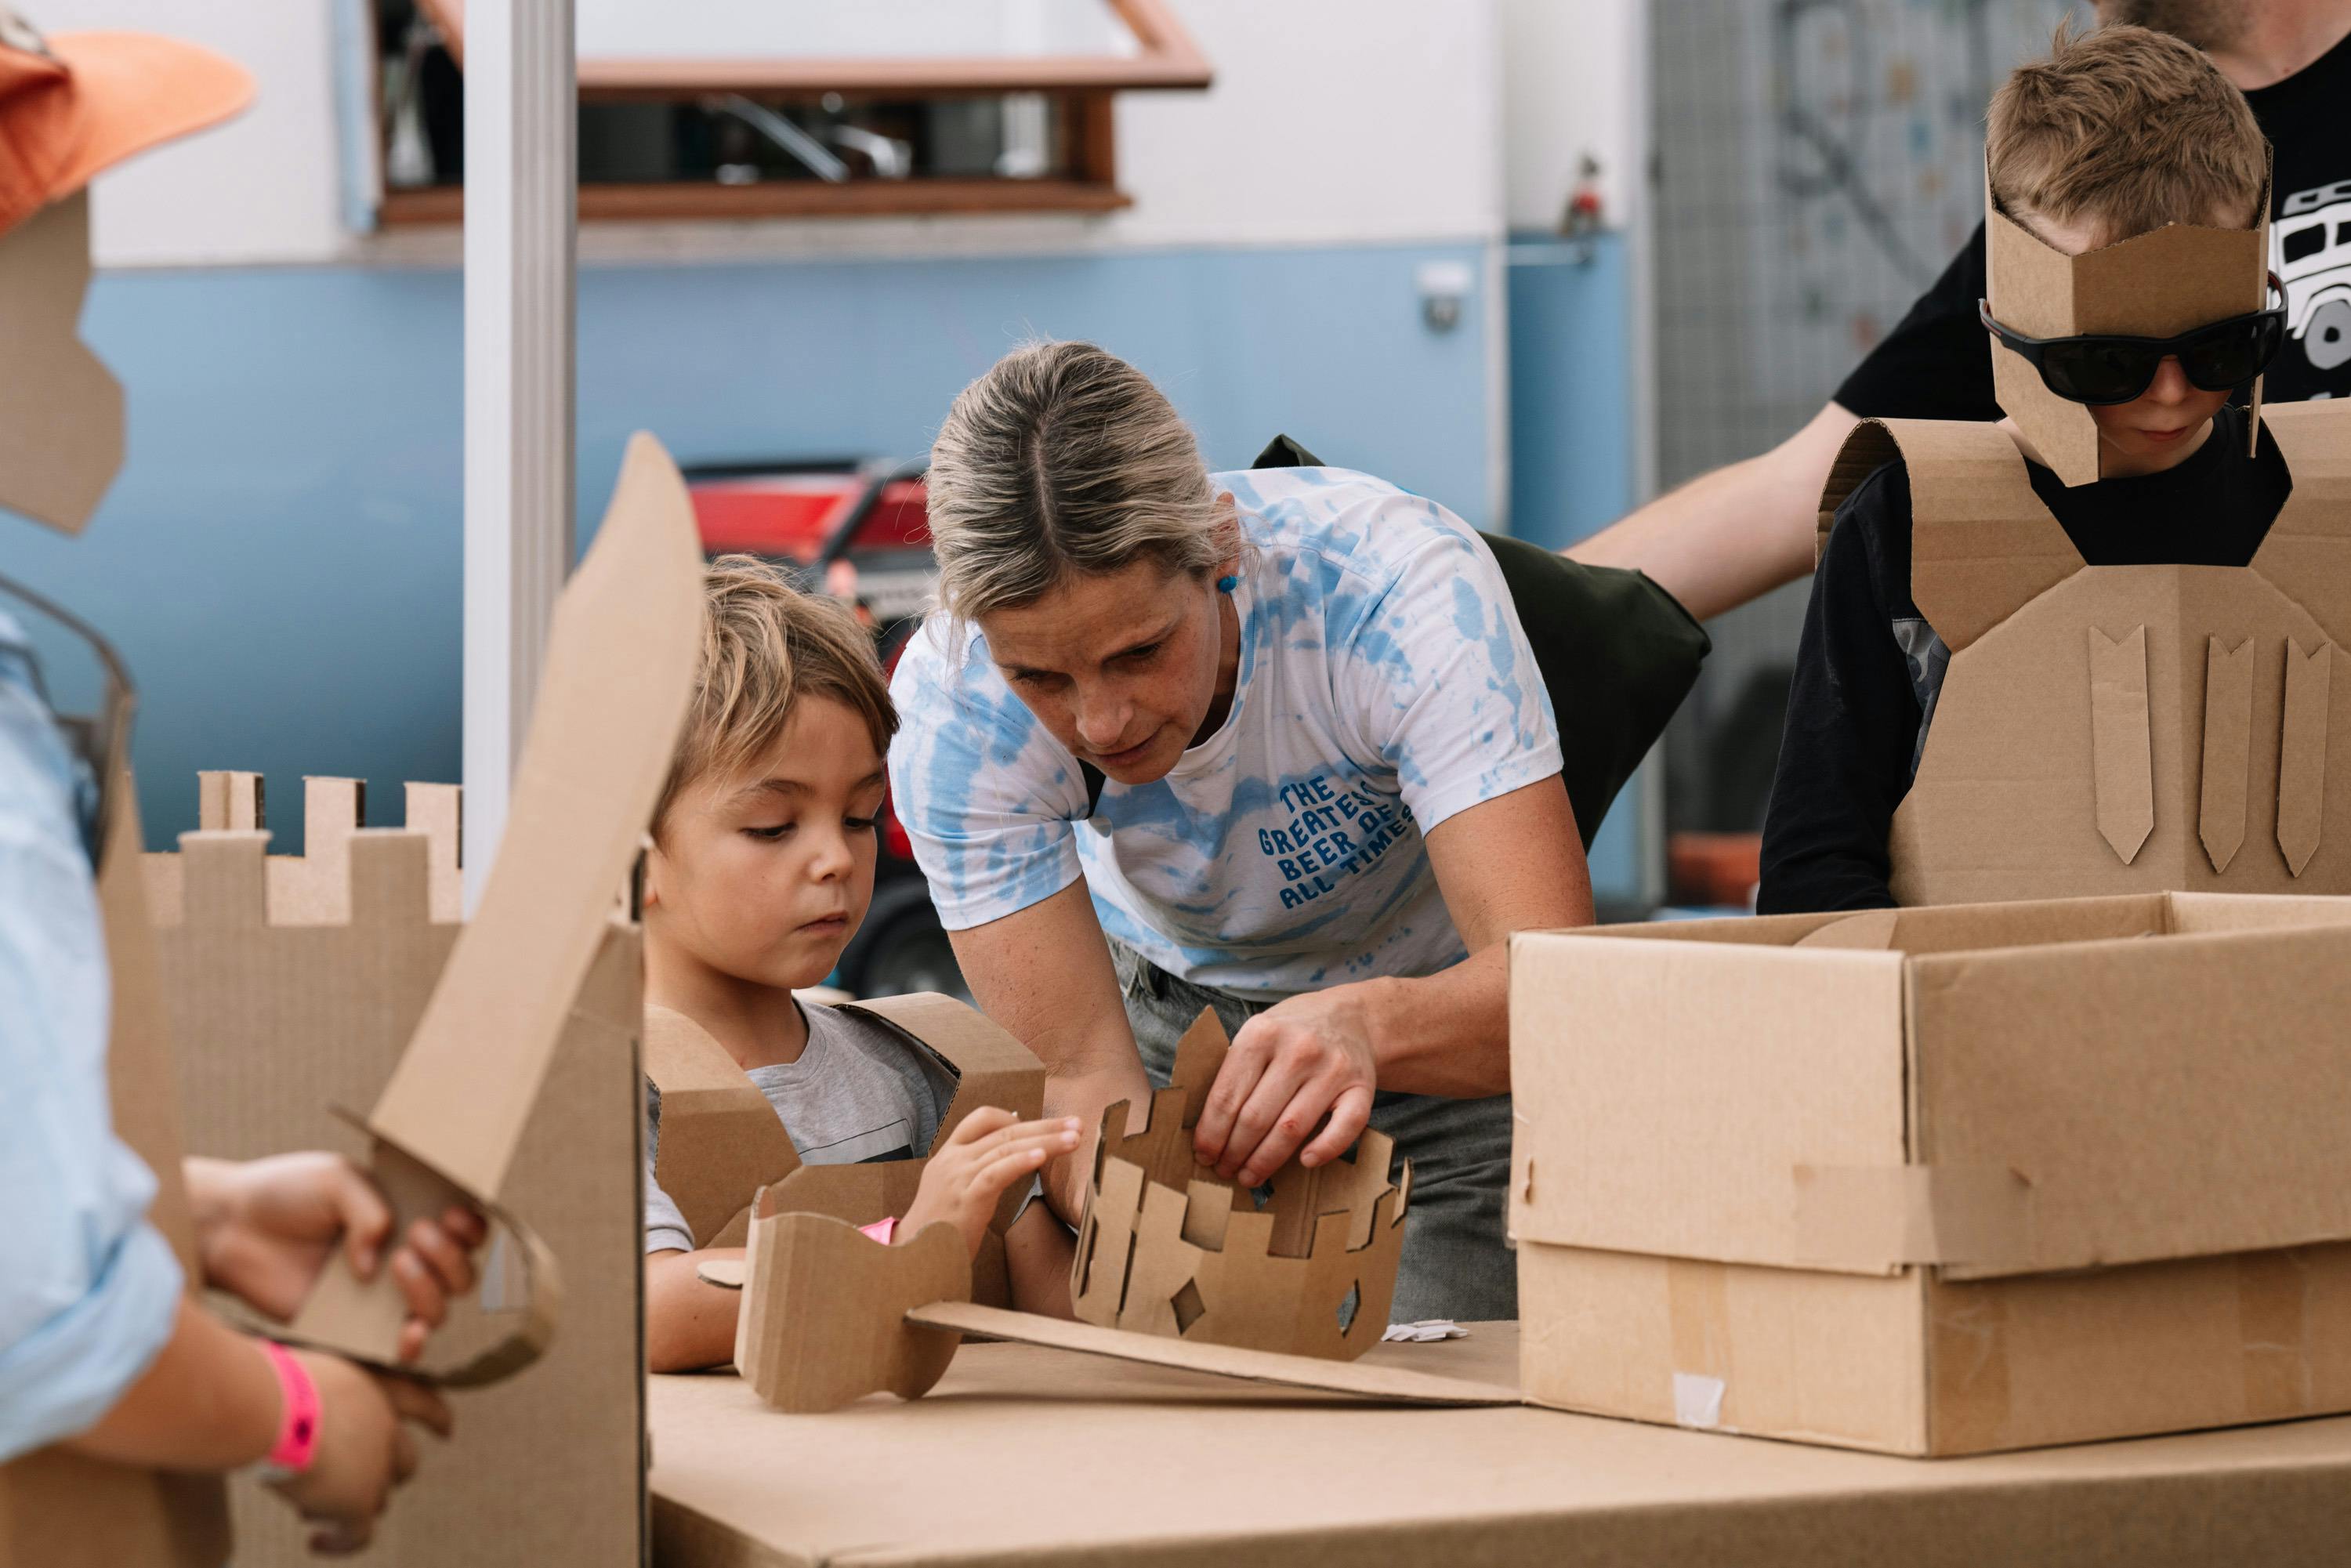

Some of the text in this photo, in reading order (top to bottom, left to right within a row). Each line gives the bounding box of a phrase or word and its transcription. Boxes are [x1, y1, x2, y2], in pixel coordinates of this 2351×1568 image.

[1279, 775, 1335, 814] THE
[1277, 803, 1393, 882] BEER OF
[1280, 805, 1414, 910] ALL TIMES
